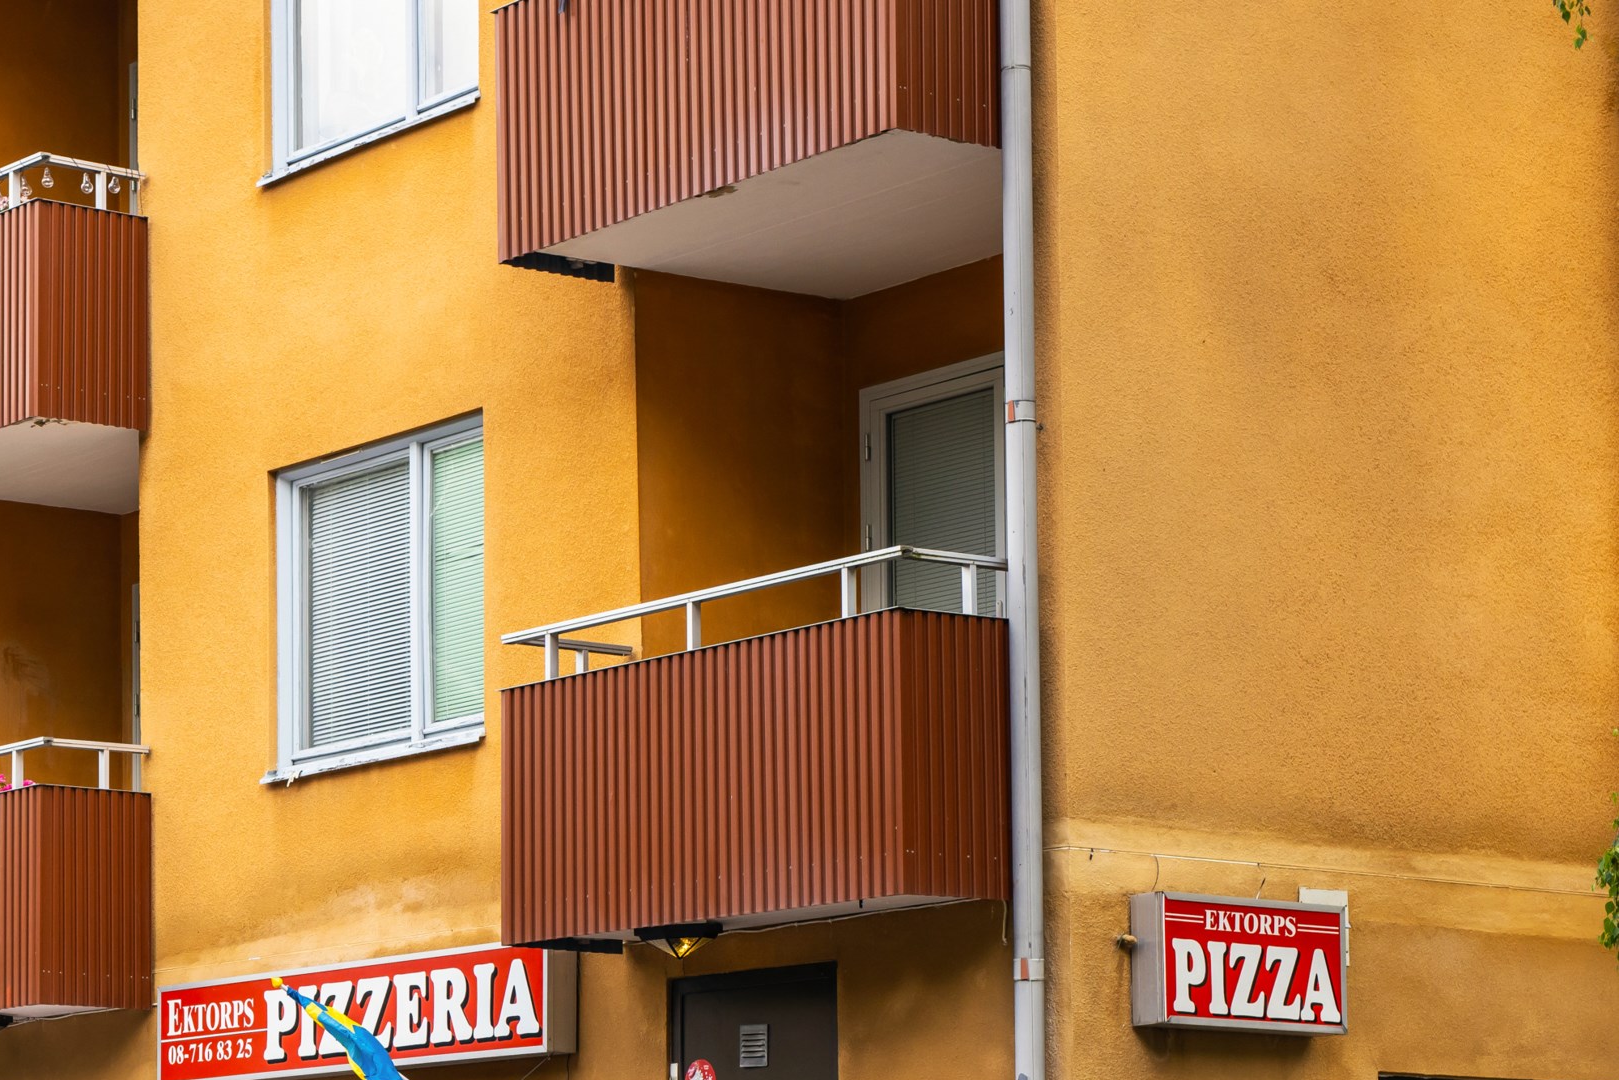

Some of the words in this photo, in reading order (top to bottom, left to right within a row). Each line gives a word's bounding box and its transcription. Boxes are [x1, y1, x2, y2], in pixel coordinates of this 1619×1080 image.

[1204, 909, 1297, 938] EKTORPS
[1171, 937, 1342, 1024] PIZZA
[263, 958, 542, 1062] PIZZERIA
[168, 1041, 213, 1066] 08-716
[216, 1039, 233, 1061] 83
[236, 1037, 253, 1059] 25
